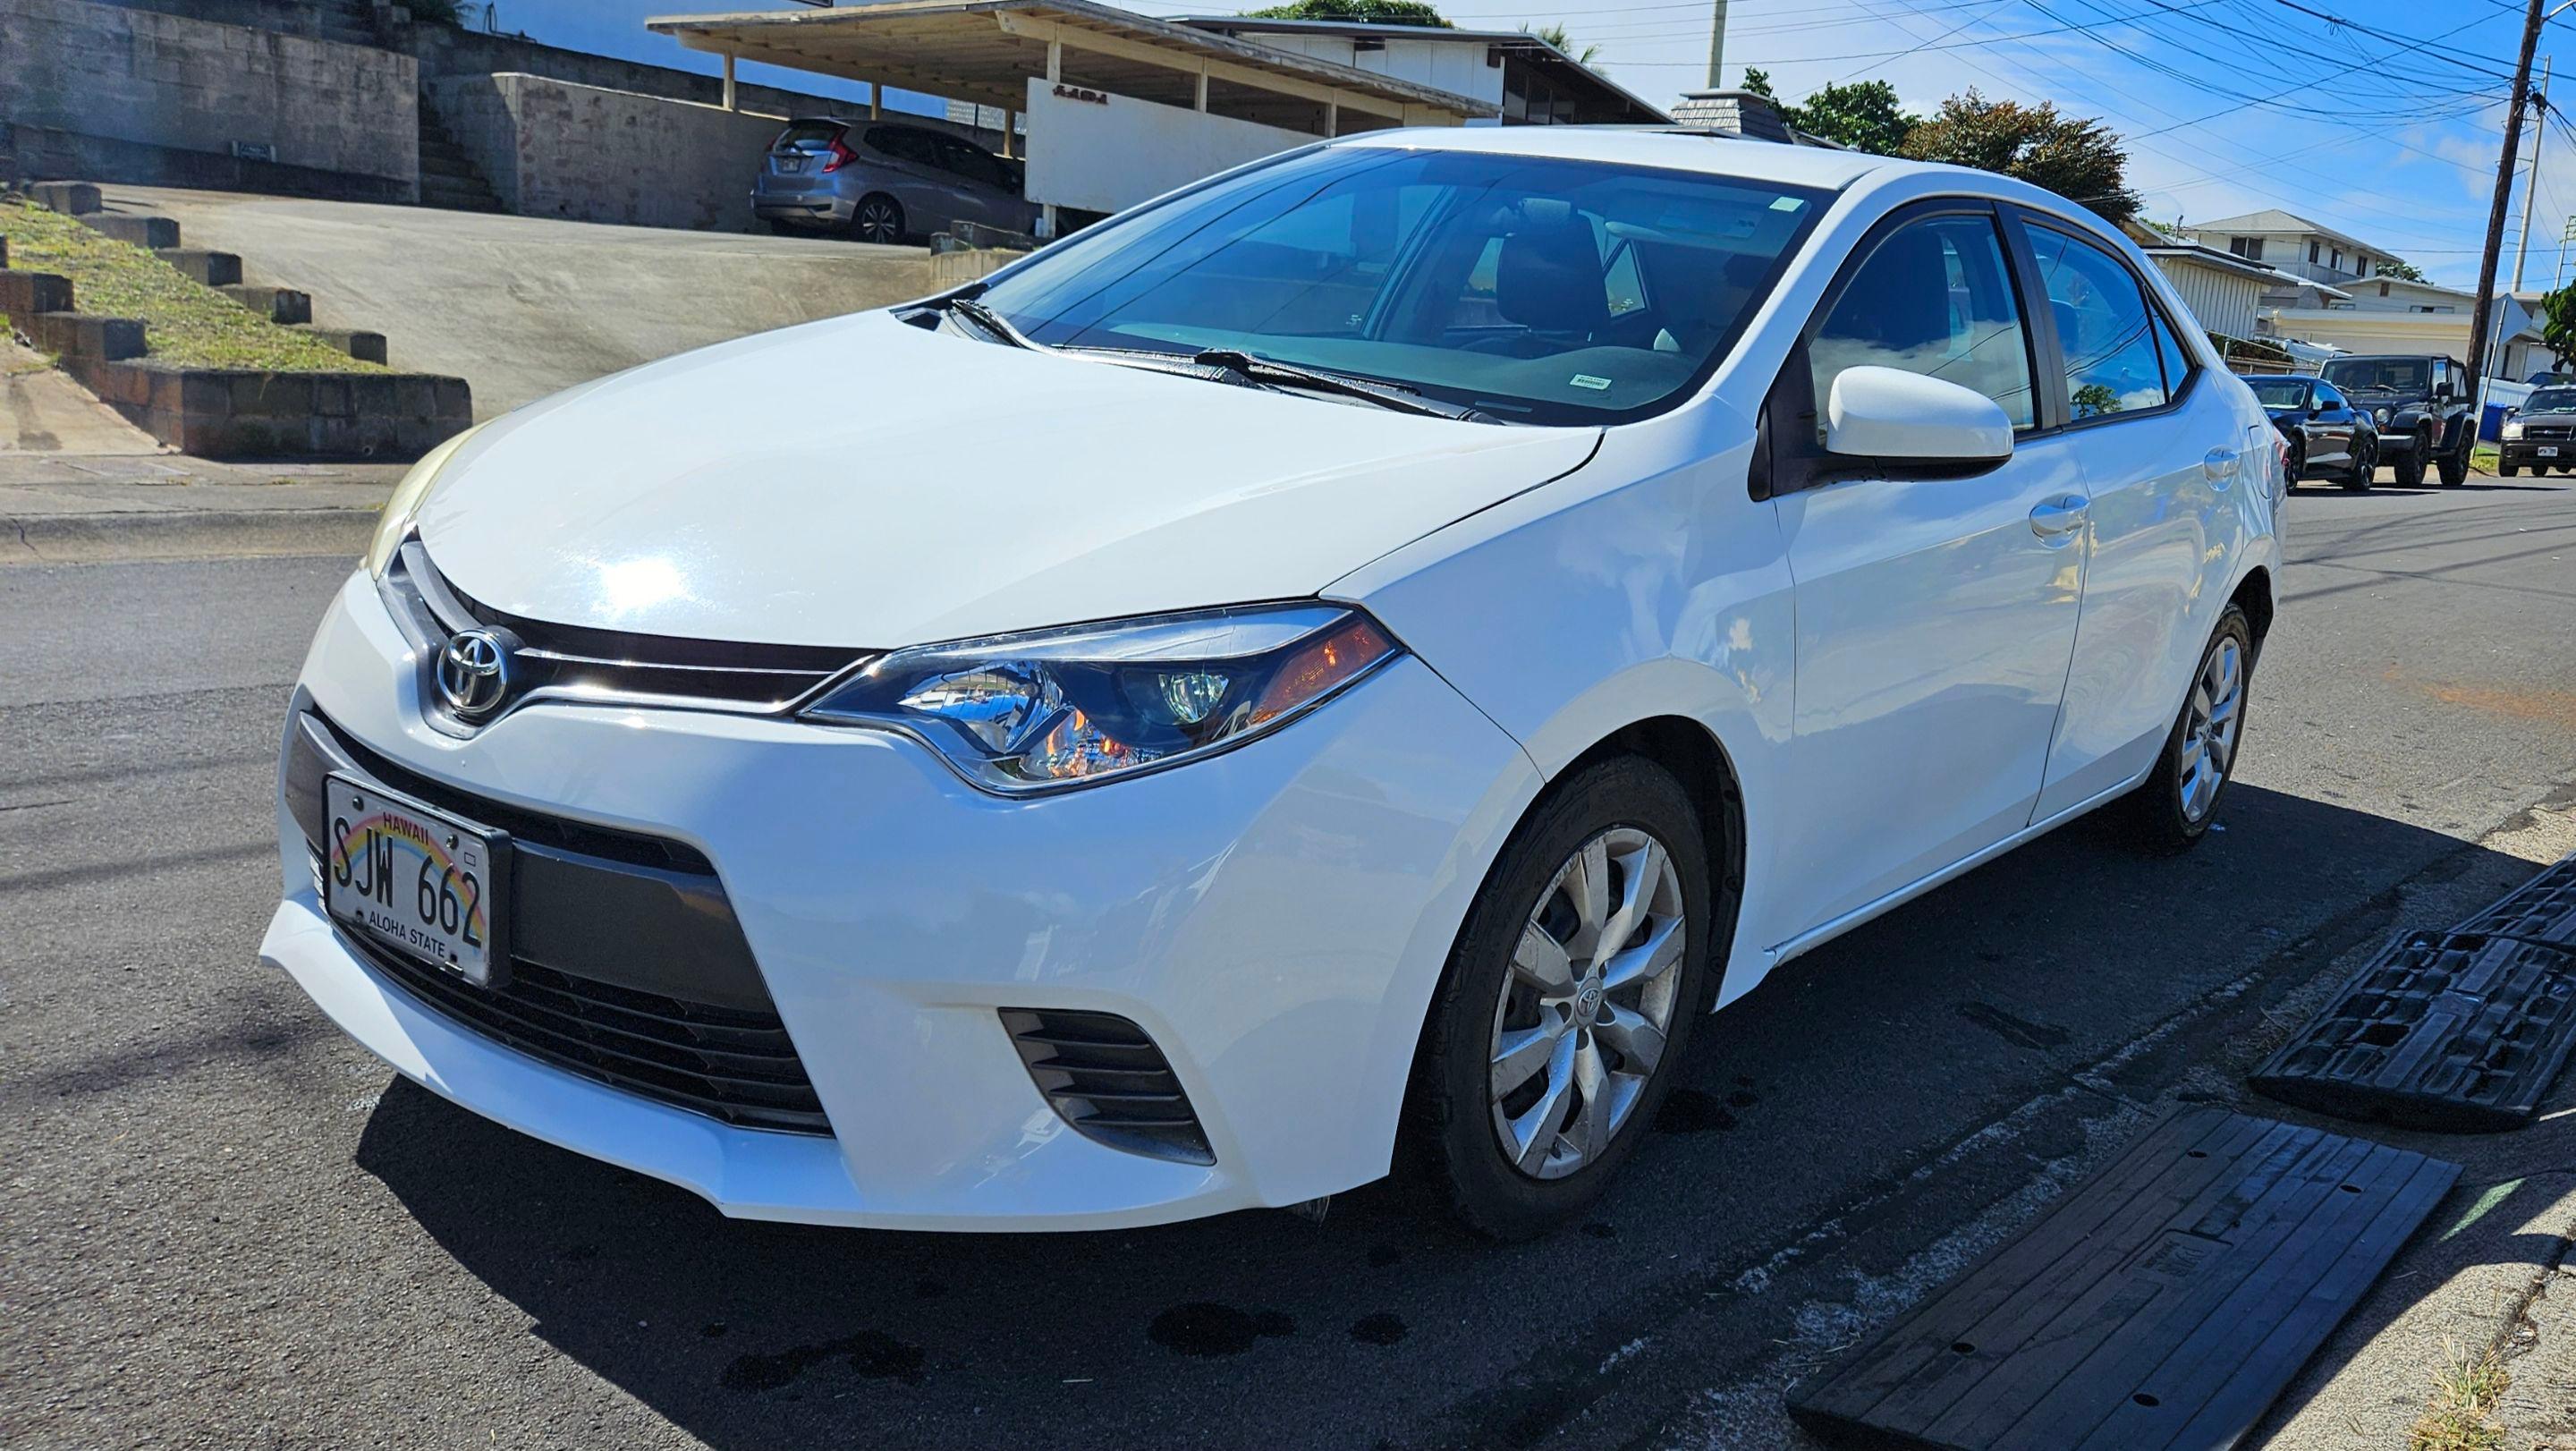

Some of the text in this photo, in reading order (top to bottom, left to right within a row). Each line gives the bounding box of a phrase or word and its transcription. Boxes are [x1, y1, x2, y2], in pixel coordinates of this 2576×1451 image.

[383, 811, 428, 845] HAWAII
[334, 817, 481, 949] SJW 662
[369, 911, 445, 958] ALOHA STATE
